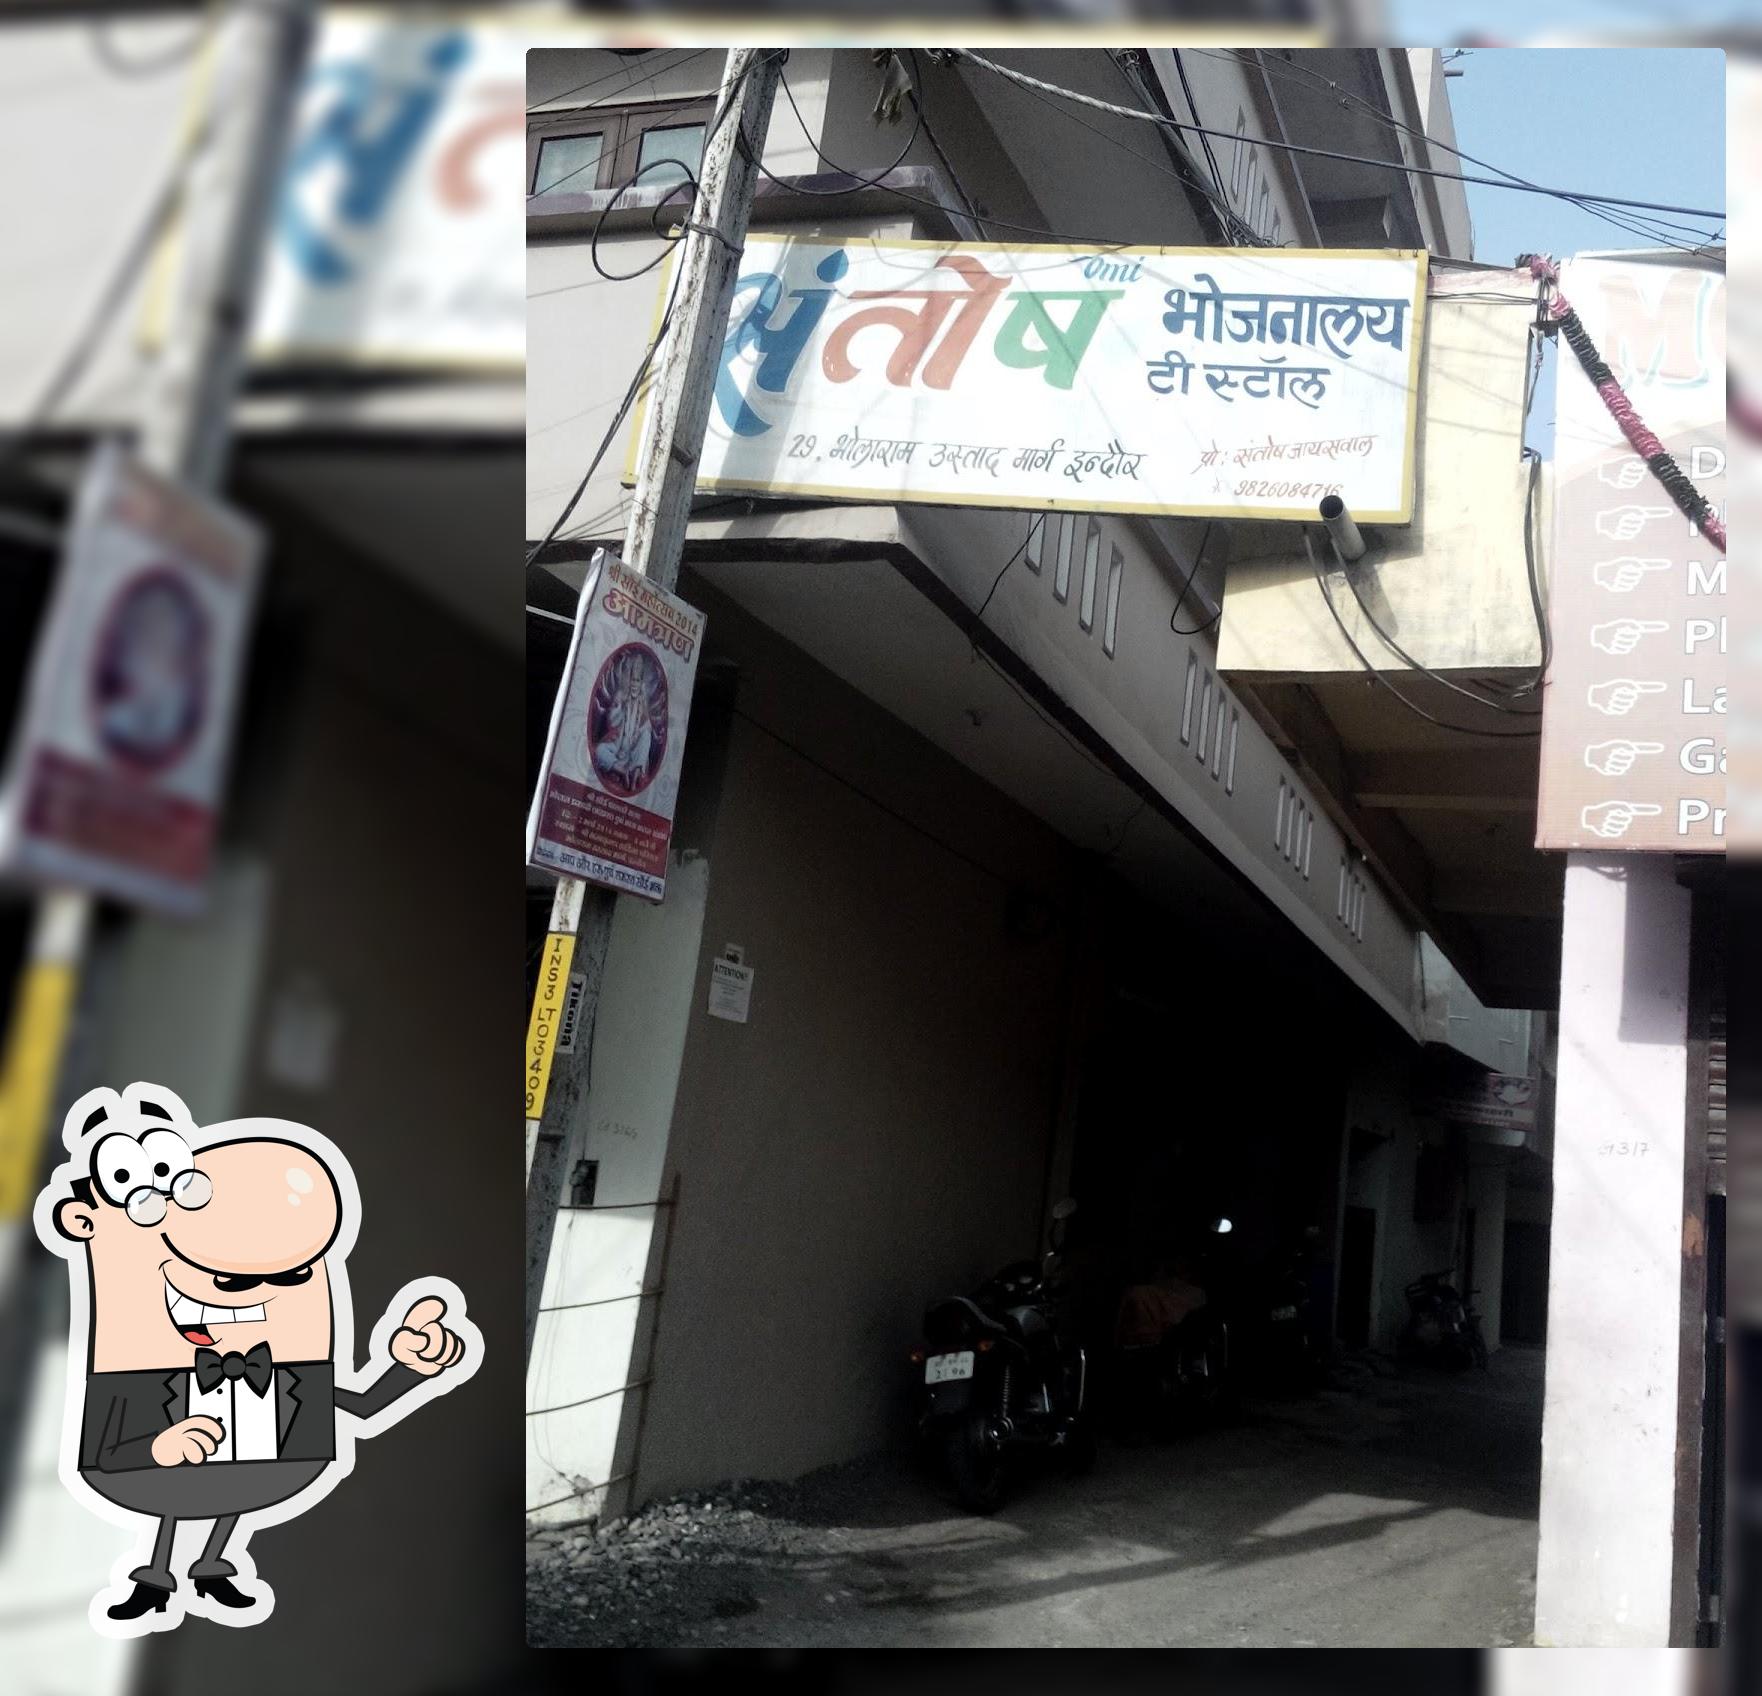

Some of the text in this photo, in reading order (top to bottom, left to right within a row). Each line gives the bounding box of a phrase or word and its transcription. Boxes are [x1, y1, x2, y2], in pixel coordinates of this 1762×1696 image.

[713, 249, 1126, 437] संतोष
[1162, 273, 1411, 359] भोजनालय
[1146, 350, 1332, 409] टी स्टॉल
[829, 426, 923, 468] भोलाराम
[929, 442, 1008, 477] उस्ताद
[1013, 438, 1066, 474] मार्ग
[1064, 438, 1148, 483] इन्दौर
[675, 612, 698, 635] 2014
